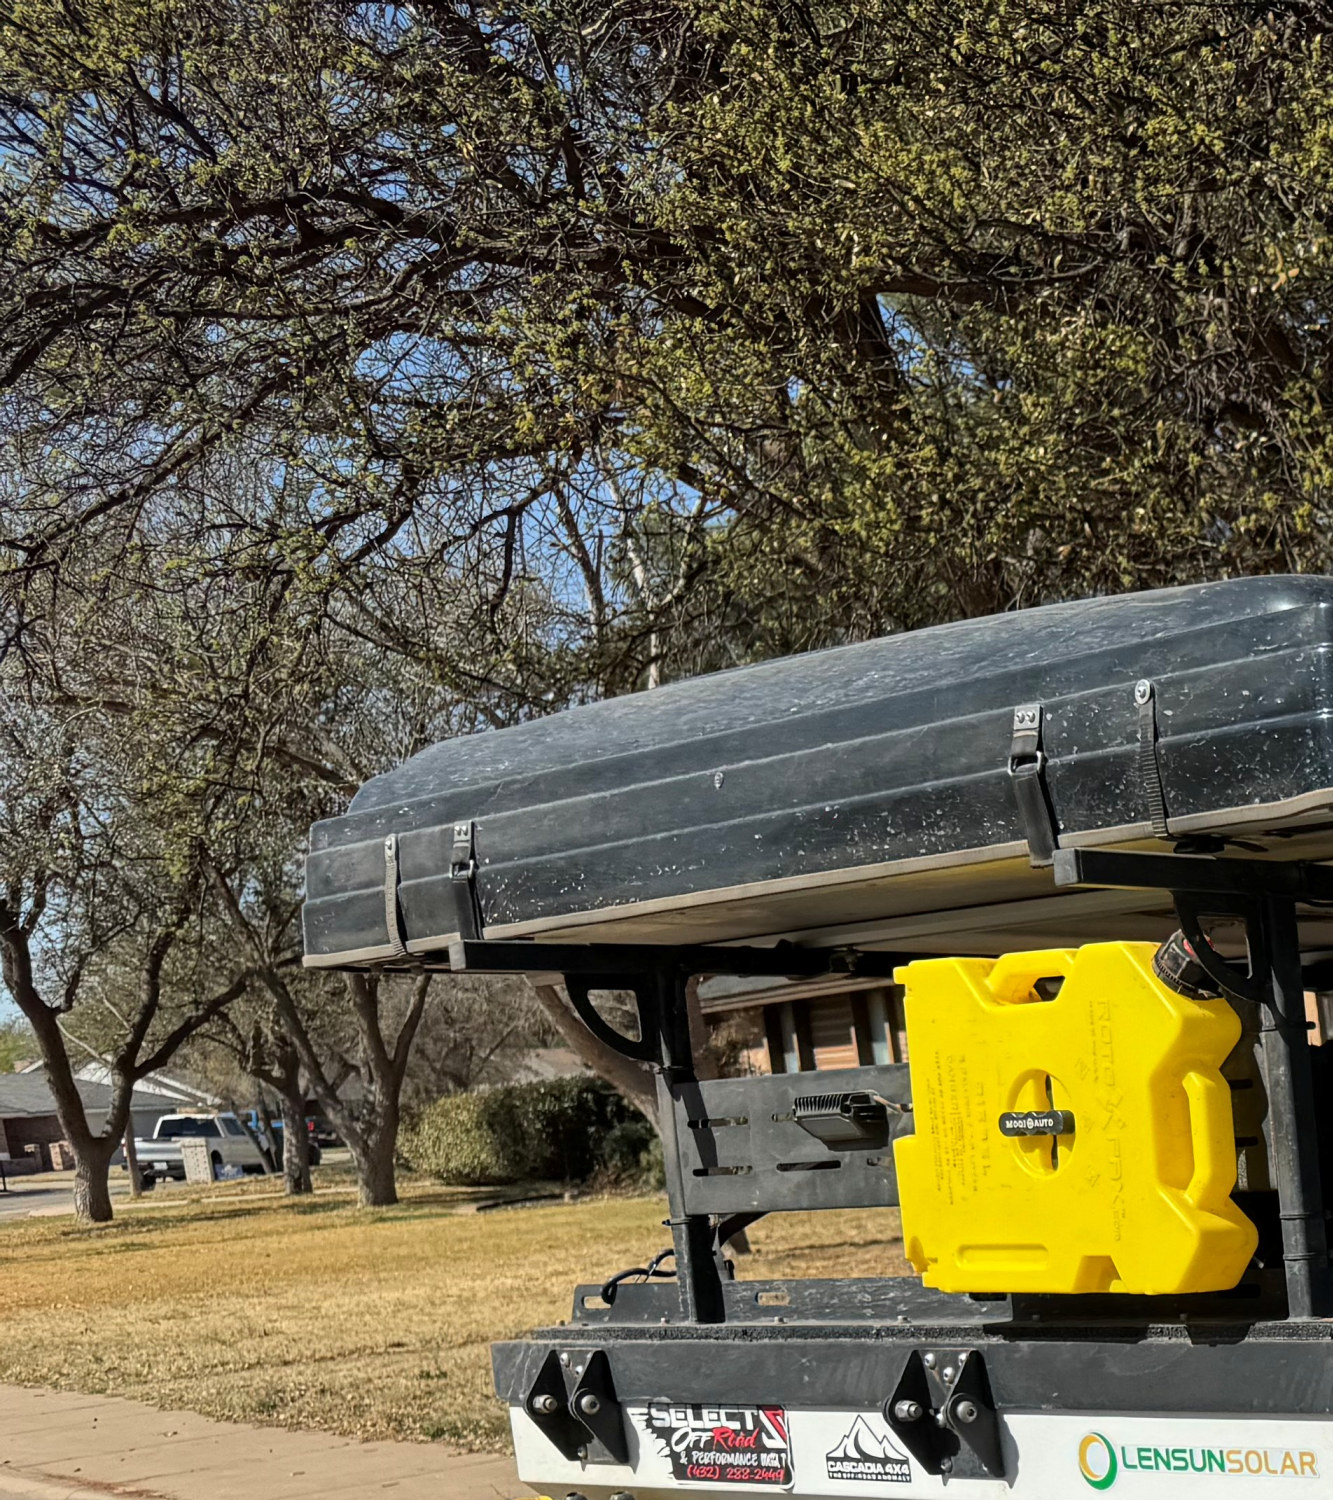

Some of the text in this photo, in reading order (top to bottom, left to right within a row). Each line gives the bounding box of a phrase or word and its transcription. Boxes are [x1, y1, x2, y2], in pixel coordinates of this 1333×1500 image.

[1034, 1118, 1054, 1128] AUTO
[650, 1404, 758, 1431] SELECT
[680, 1452, 688, 1465] &
[692, 1451, 758, 1466] PERFORMANCE
[1121, 1446, 1318, 1476] LENSUNSOLAR
[686, 1466, 785, 1482] (432) 288-2449
[827, 1461, 884, 1474] CASCADIA
